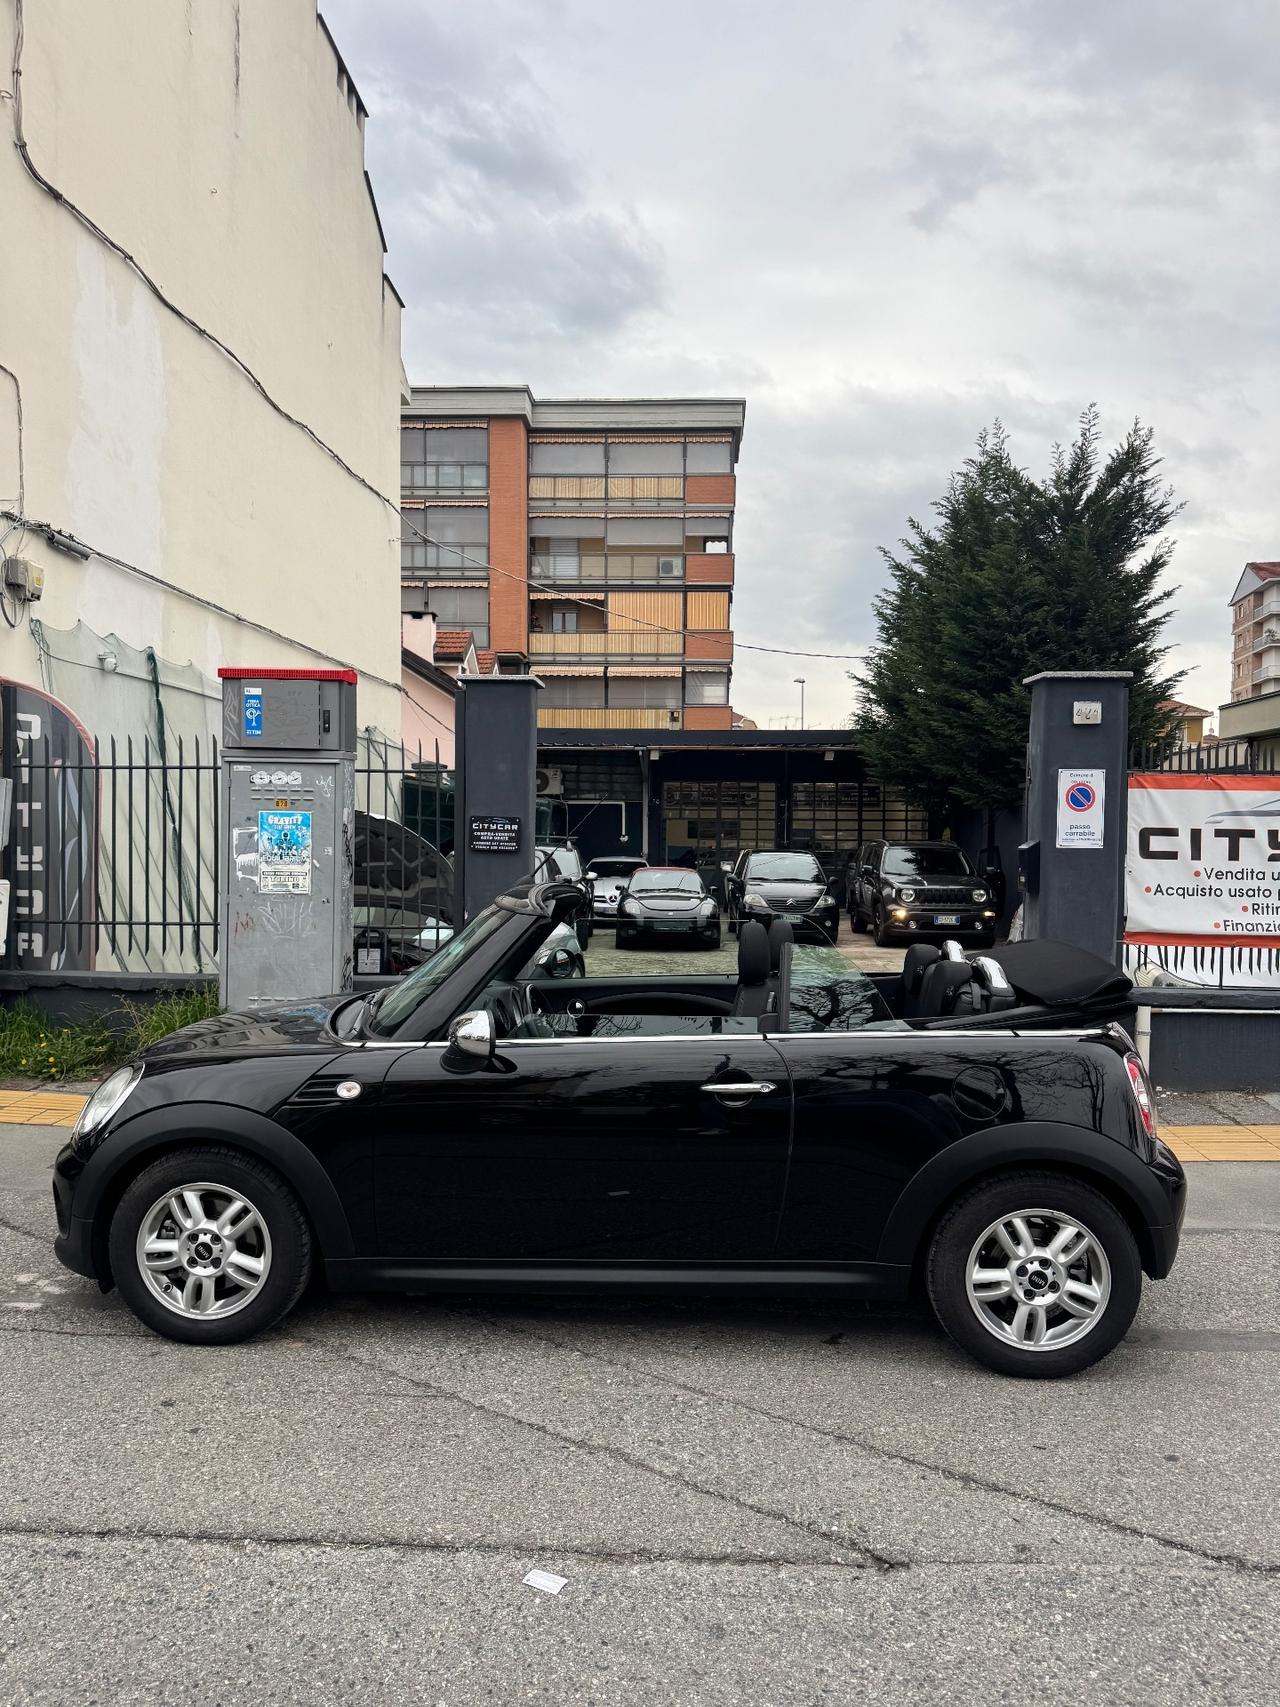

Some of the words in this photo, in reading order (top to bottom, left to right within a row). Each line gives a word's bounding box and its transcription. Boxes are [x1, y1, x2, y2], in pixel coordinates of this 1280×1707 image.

[267, 814, 303, 825] GRAVITY
[1203, 867, 1266, 880] Vendita
[1153, 883, 1223, 899] Acquisto
[1228, 885, 1272, 898] usato
